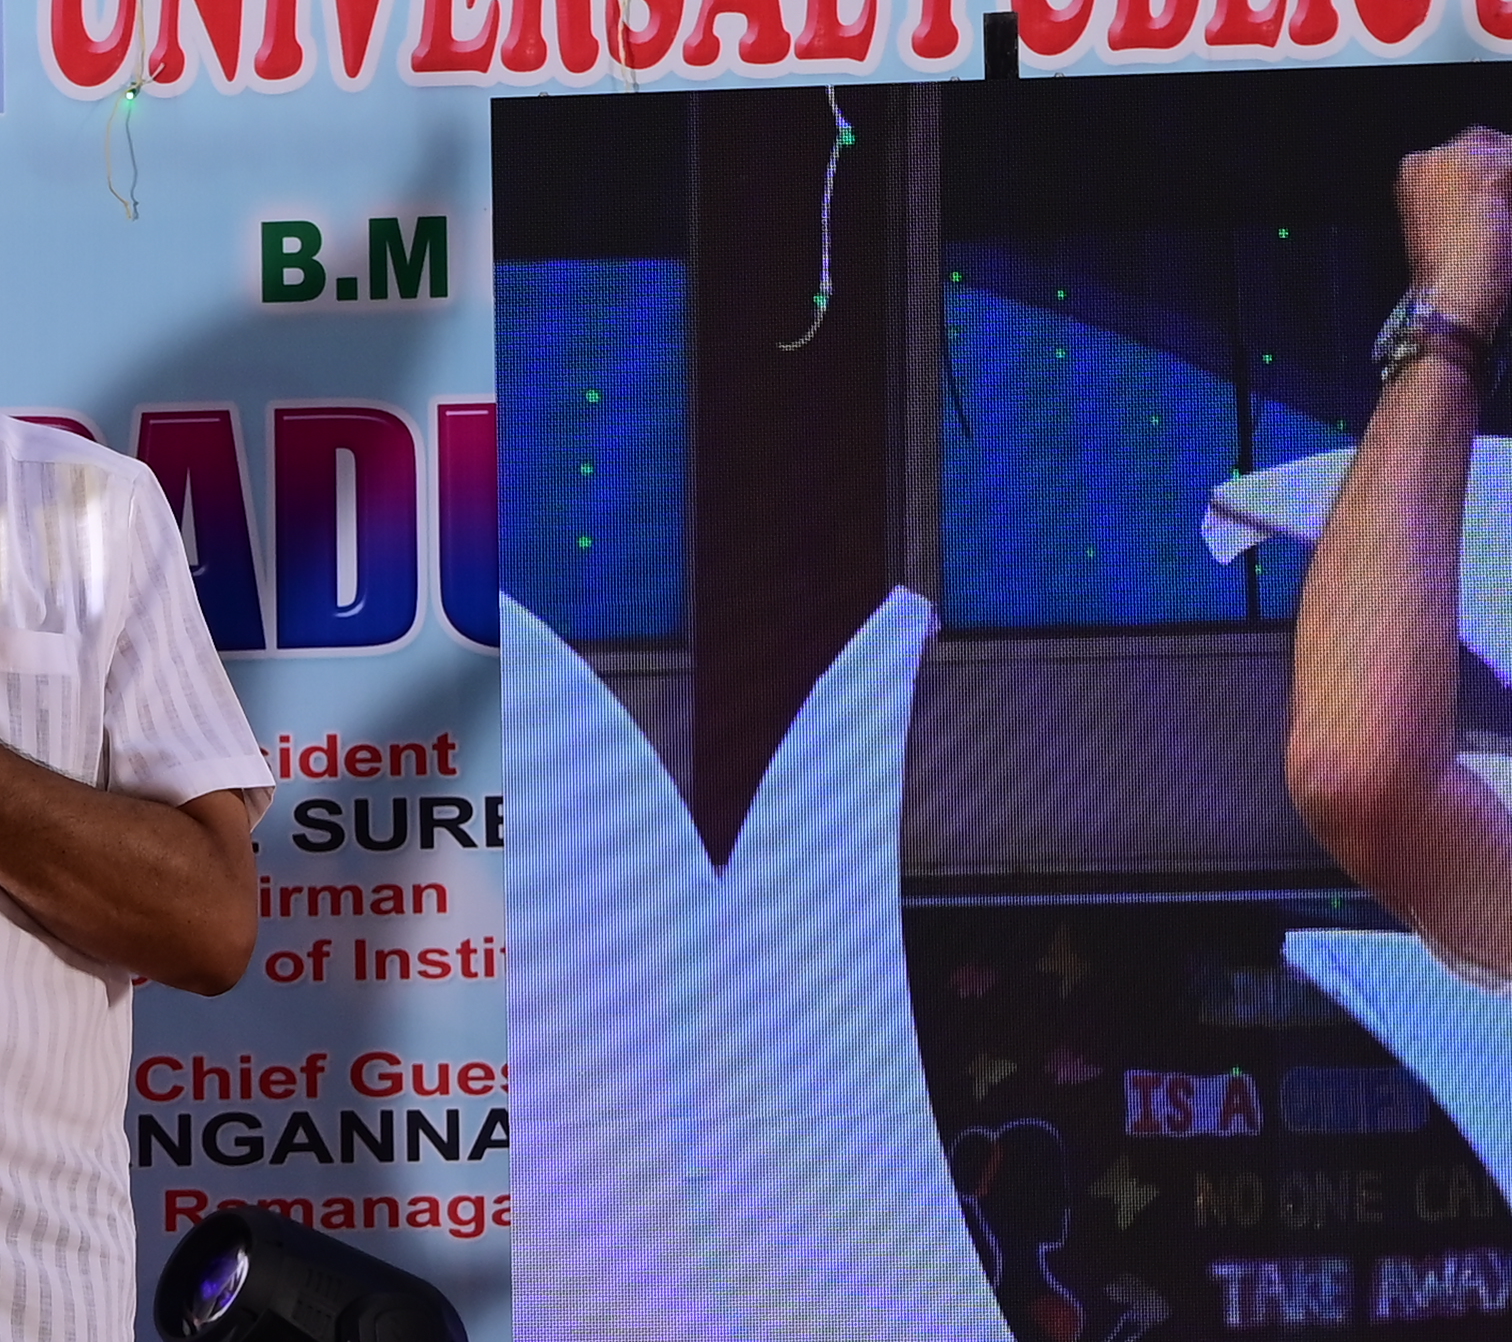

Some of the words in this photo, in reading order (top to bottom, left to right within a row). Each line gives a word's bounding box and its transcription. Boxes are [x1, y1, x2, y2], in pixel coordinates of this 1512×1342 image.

[260, 215, 450, 304] B.M
[16, 401, 500, 651] AD
[261, 732, 458, 779] ident
[265, 939, 333, 983] of
[354, 935, 507, 981] Insti
[134, 1053, 328, 1103] Chief
[1131, 1074, 1193, 1134] IS
[1220, 1074, 1262, 1131] A
[130, 1108, 508, 1168] NGANNA
[1208, 1259, 1353, 1327] TAKE
